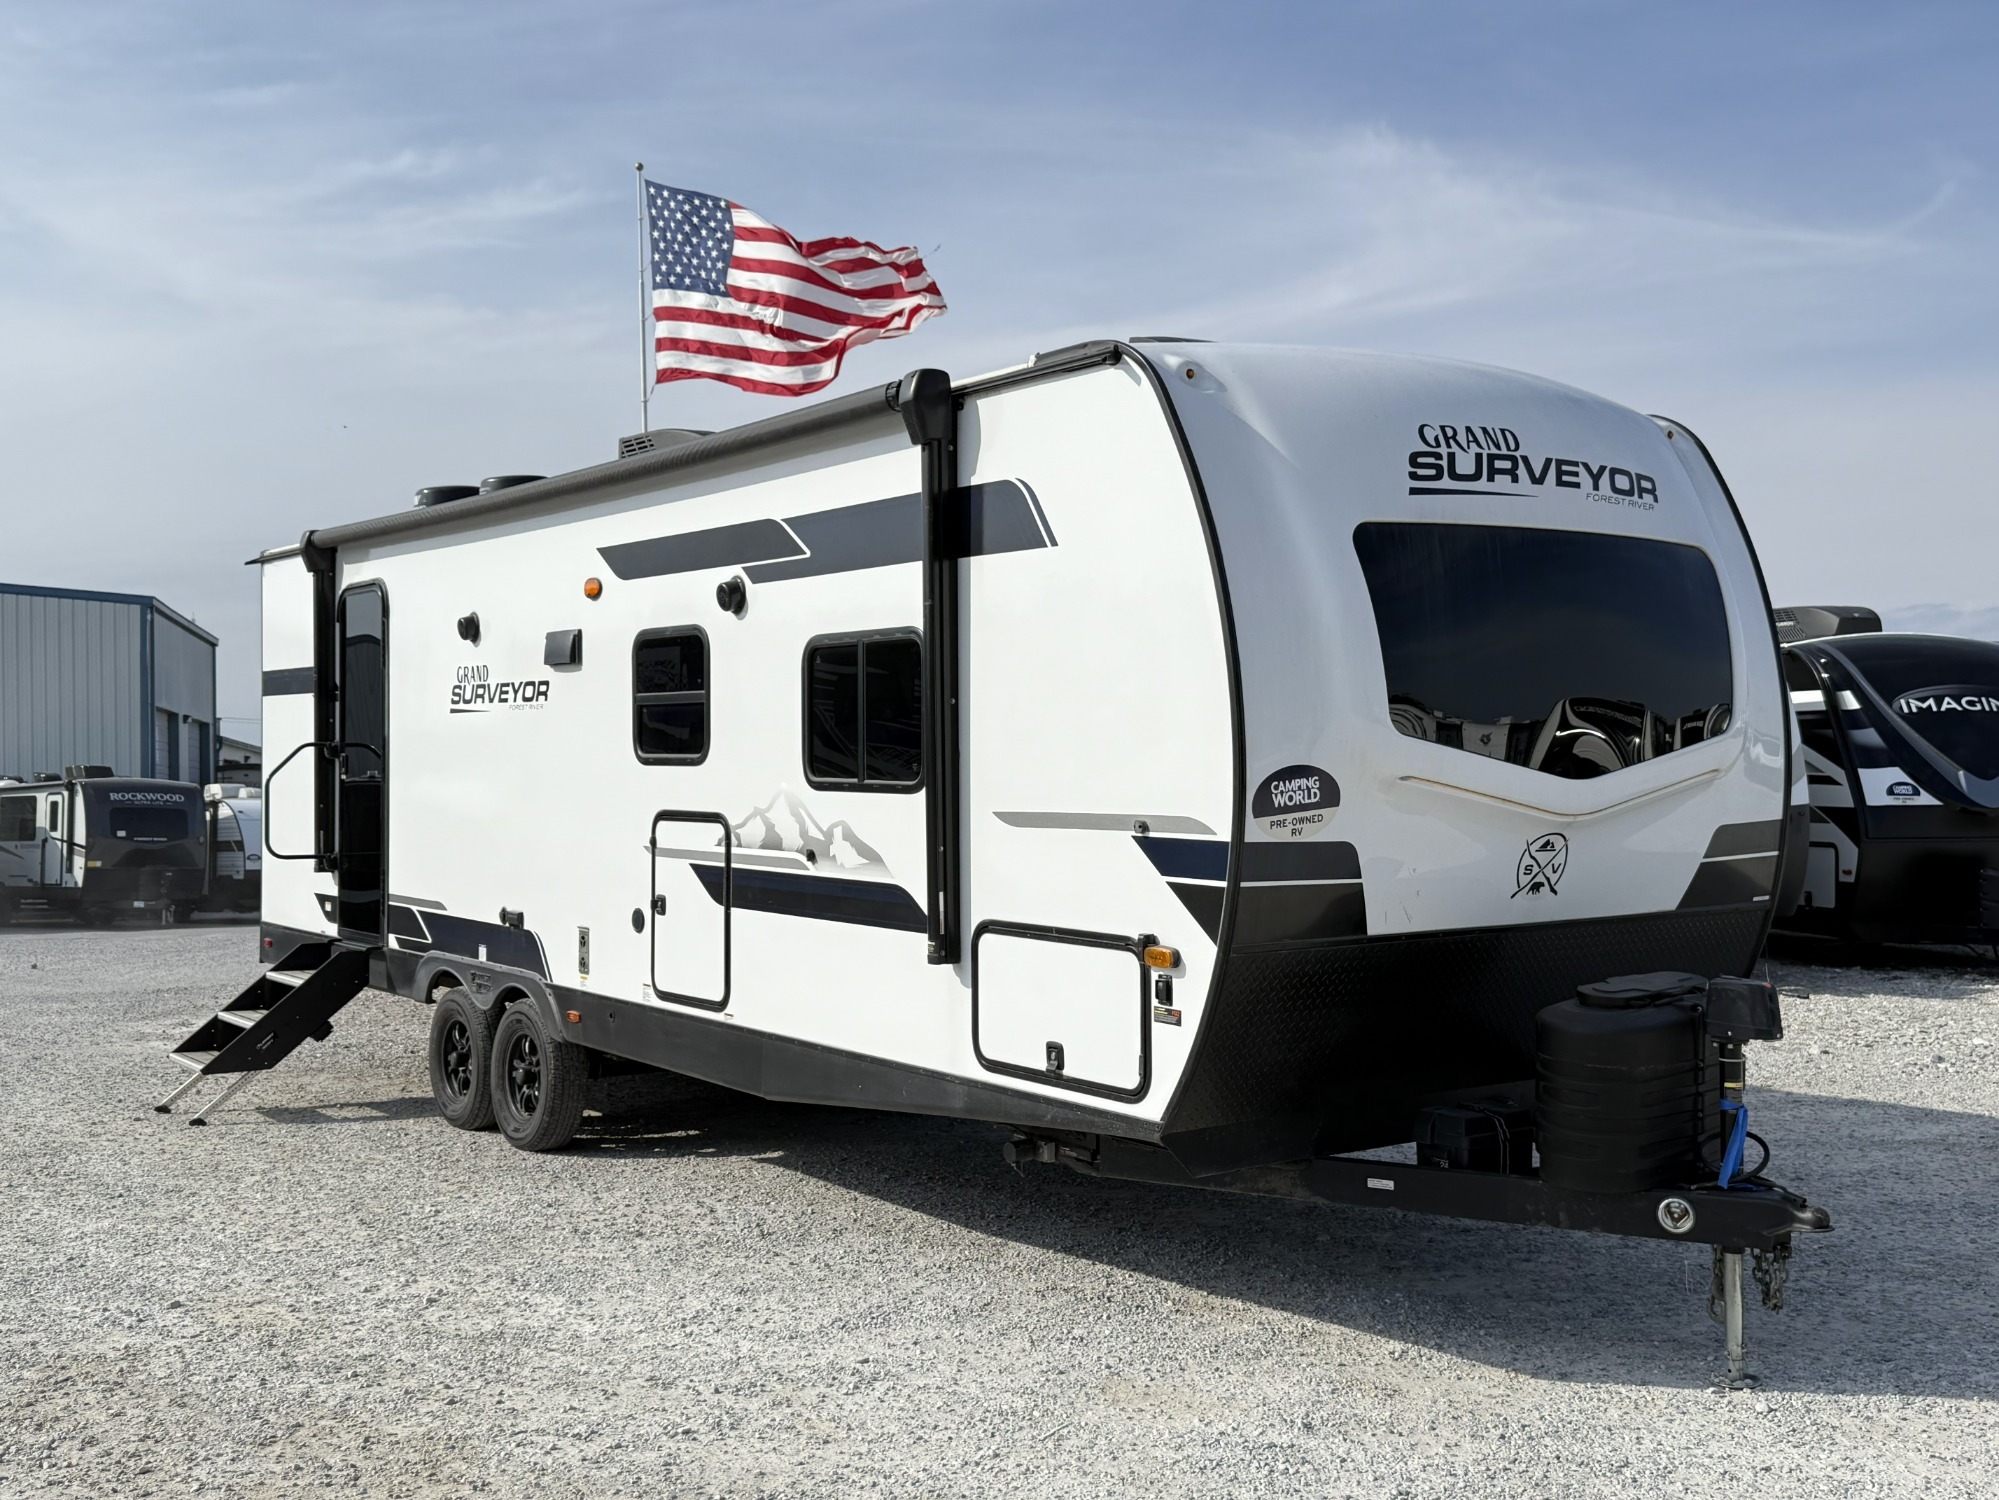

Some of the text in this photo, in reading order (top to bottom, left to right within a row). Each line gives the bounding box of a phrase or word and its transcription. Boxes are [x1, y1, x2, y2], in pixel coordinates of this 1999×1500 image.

[1418, 424, 1520, 453] GRAND
[1408, 451, 1659, 504] SURVEYOR
[1585, 492, 1655, 511] FOREST RIVER
[456, 665, 489, 685] GRAND
[451, 680, 550, 704] SURVEYOR
[1270, 776, 1320, 794] CAMPING
[109, 792, 185, 802] ROCKWOOD
[1272, 788, 1320, 808] WORLD
[1269, 814, 1324, 830] PRE-OWNED
[1291, 827, 1303, 837] RV
[1523, 863, 1562, 875] S V
